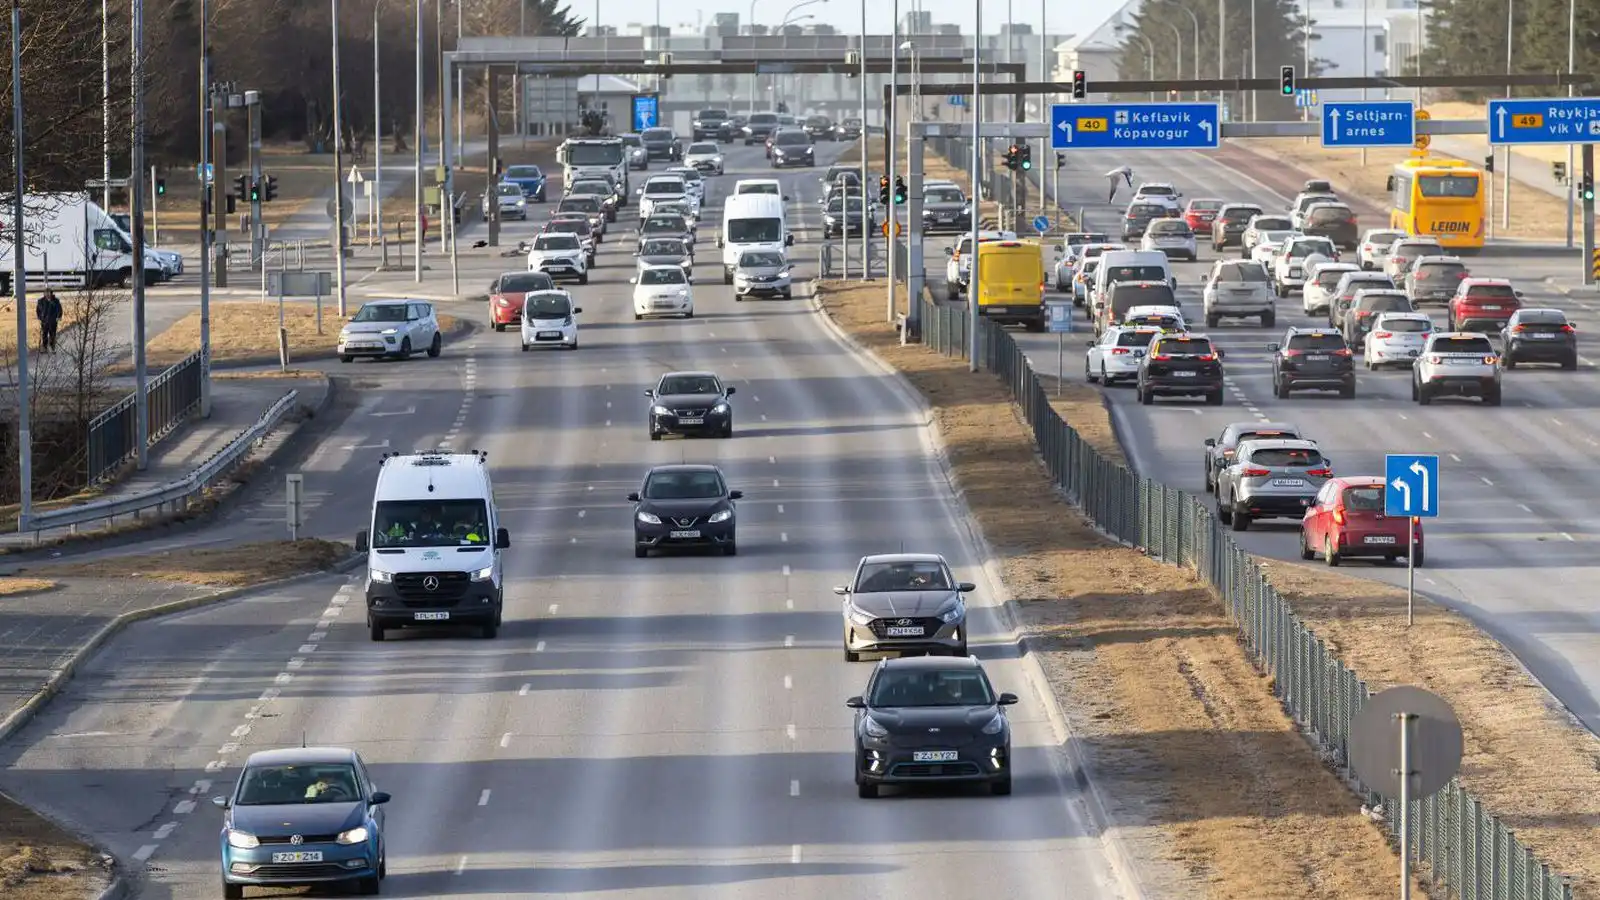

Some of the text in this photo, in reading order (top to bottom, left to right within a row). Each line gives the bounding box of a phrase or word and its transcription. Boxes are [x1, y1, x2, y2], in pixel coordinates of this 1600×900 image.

[1346, 110, 1408, 123] Seltjarn-
[1520, 116, 1536, 126] 49
[1084, 120, 1101, 129] 40
[1574, 123, 1584, 133] V
[1115, 127, 1189, 140] Kópavogur
[1346, 127, 1385, 137] arnes
[302, 852, 319, 861] Z14
